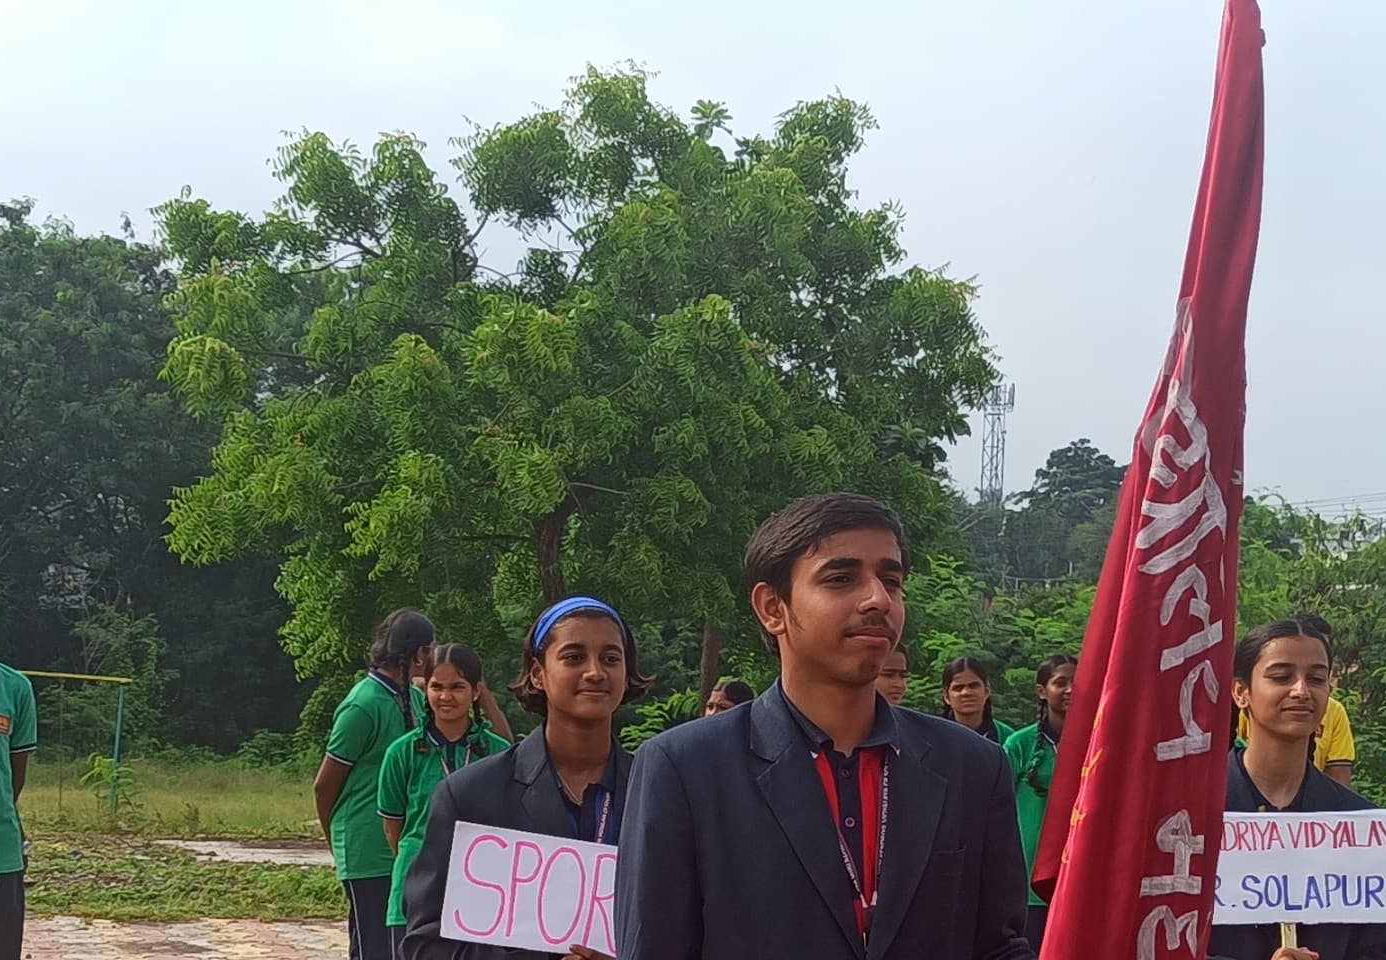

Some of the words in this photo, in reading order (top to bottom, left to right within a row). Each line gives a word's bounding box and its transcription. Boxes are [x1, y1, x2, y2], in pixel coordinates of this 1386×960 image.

[1220, 821, 1285, 851] DRIYA
[454, 834, 617, 957] SPOR
[1241, 873, 1385, 911] SOLAPUR
